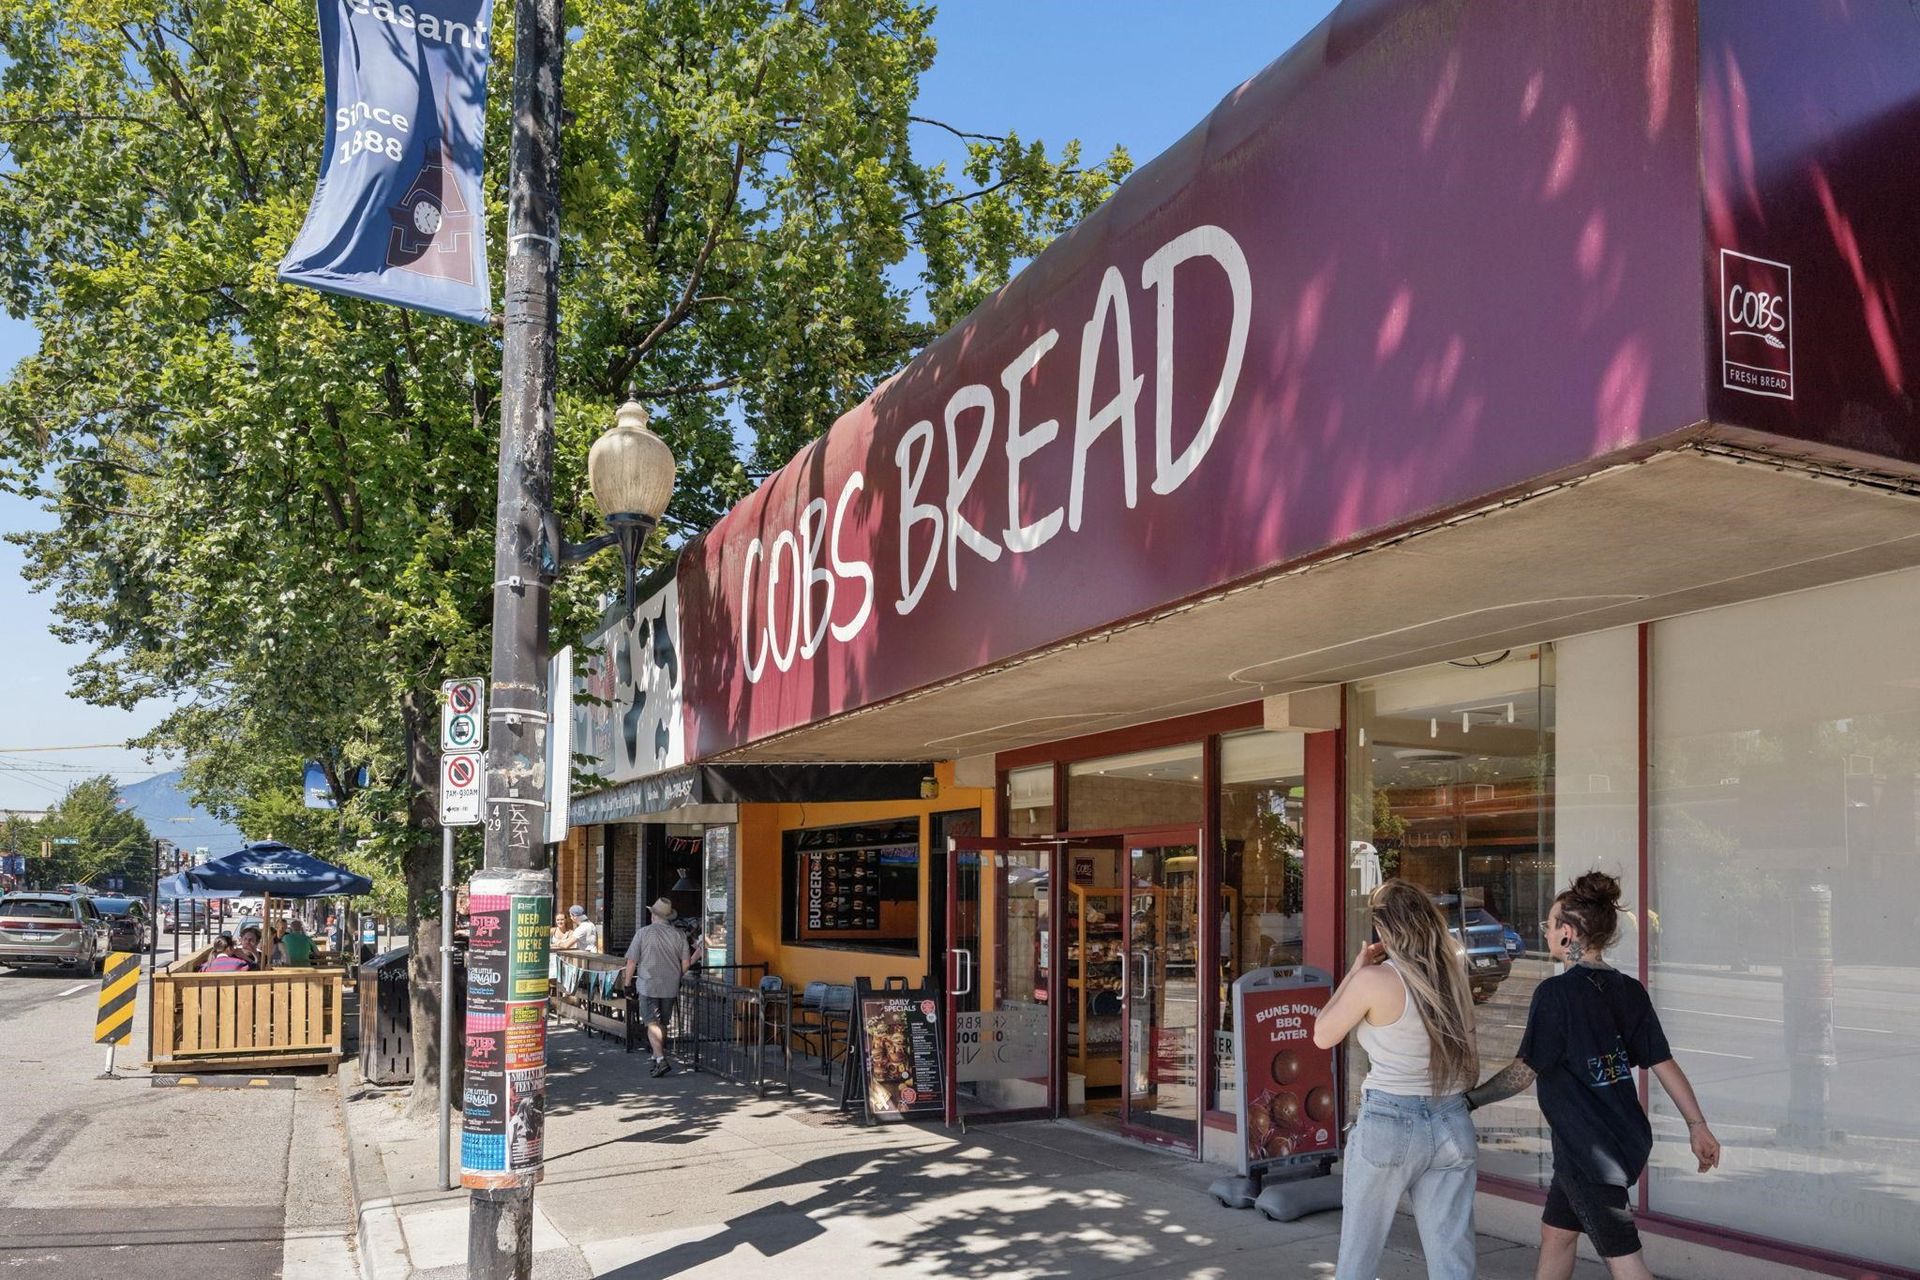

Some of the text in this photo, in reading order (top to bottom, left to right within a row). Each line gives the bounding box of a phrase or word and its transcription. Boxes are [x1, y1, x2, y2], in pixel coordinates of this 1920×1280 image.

[336, 101, 409, 133] Since
[339, 129, 403, 164] 1888
[1729, 284, 1785, 332] COBS
[1730, 369, 1787, 389] FRESH BREAD
[741, 225, 1252, 683] COBS BREAD
[493, 805, 500, 817] 4
[488, 818, 501, 831] 29
[518, 913, 540, 925] NEED
[517, 938, 543, 950] WE'RE
[1256, 1004, 1322, 1023] BUNS NOW
[1276, 1017, 1302, 1028] BBQ
[1270, 1029, 1308, 1042] LATER
